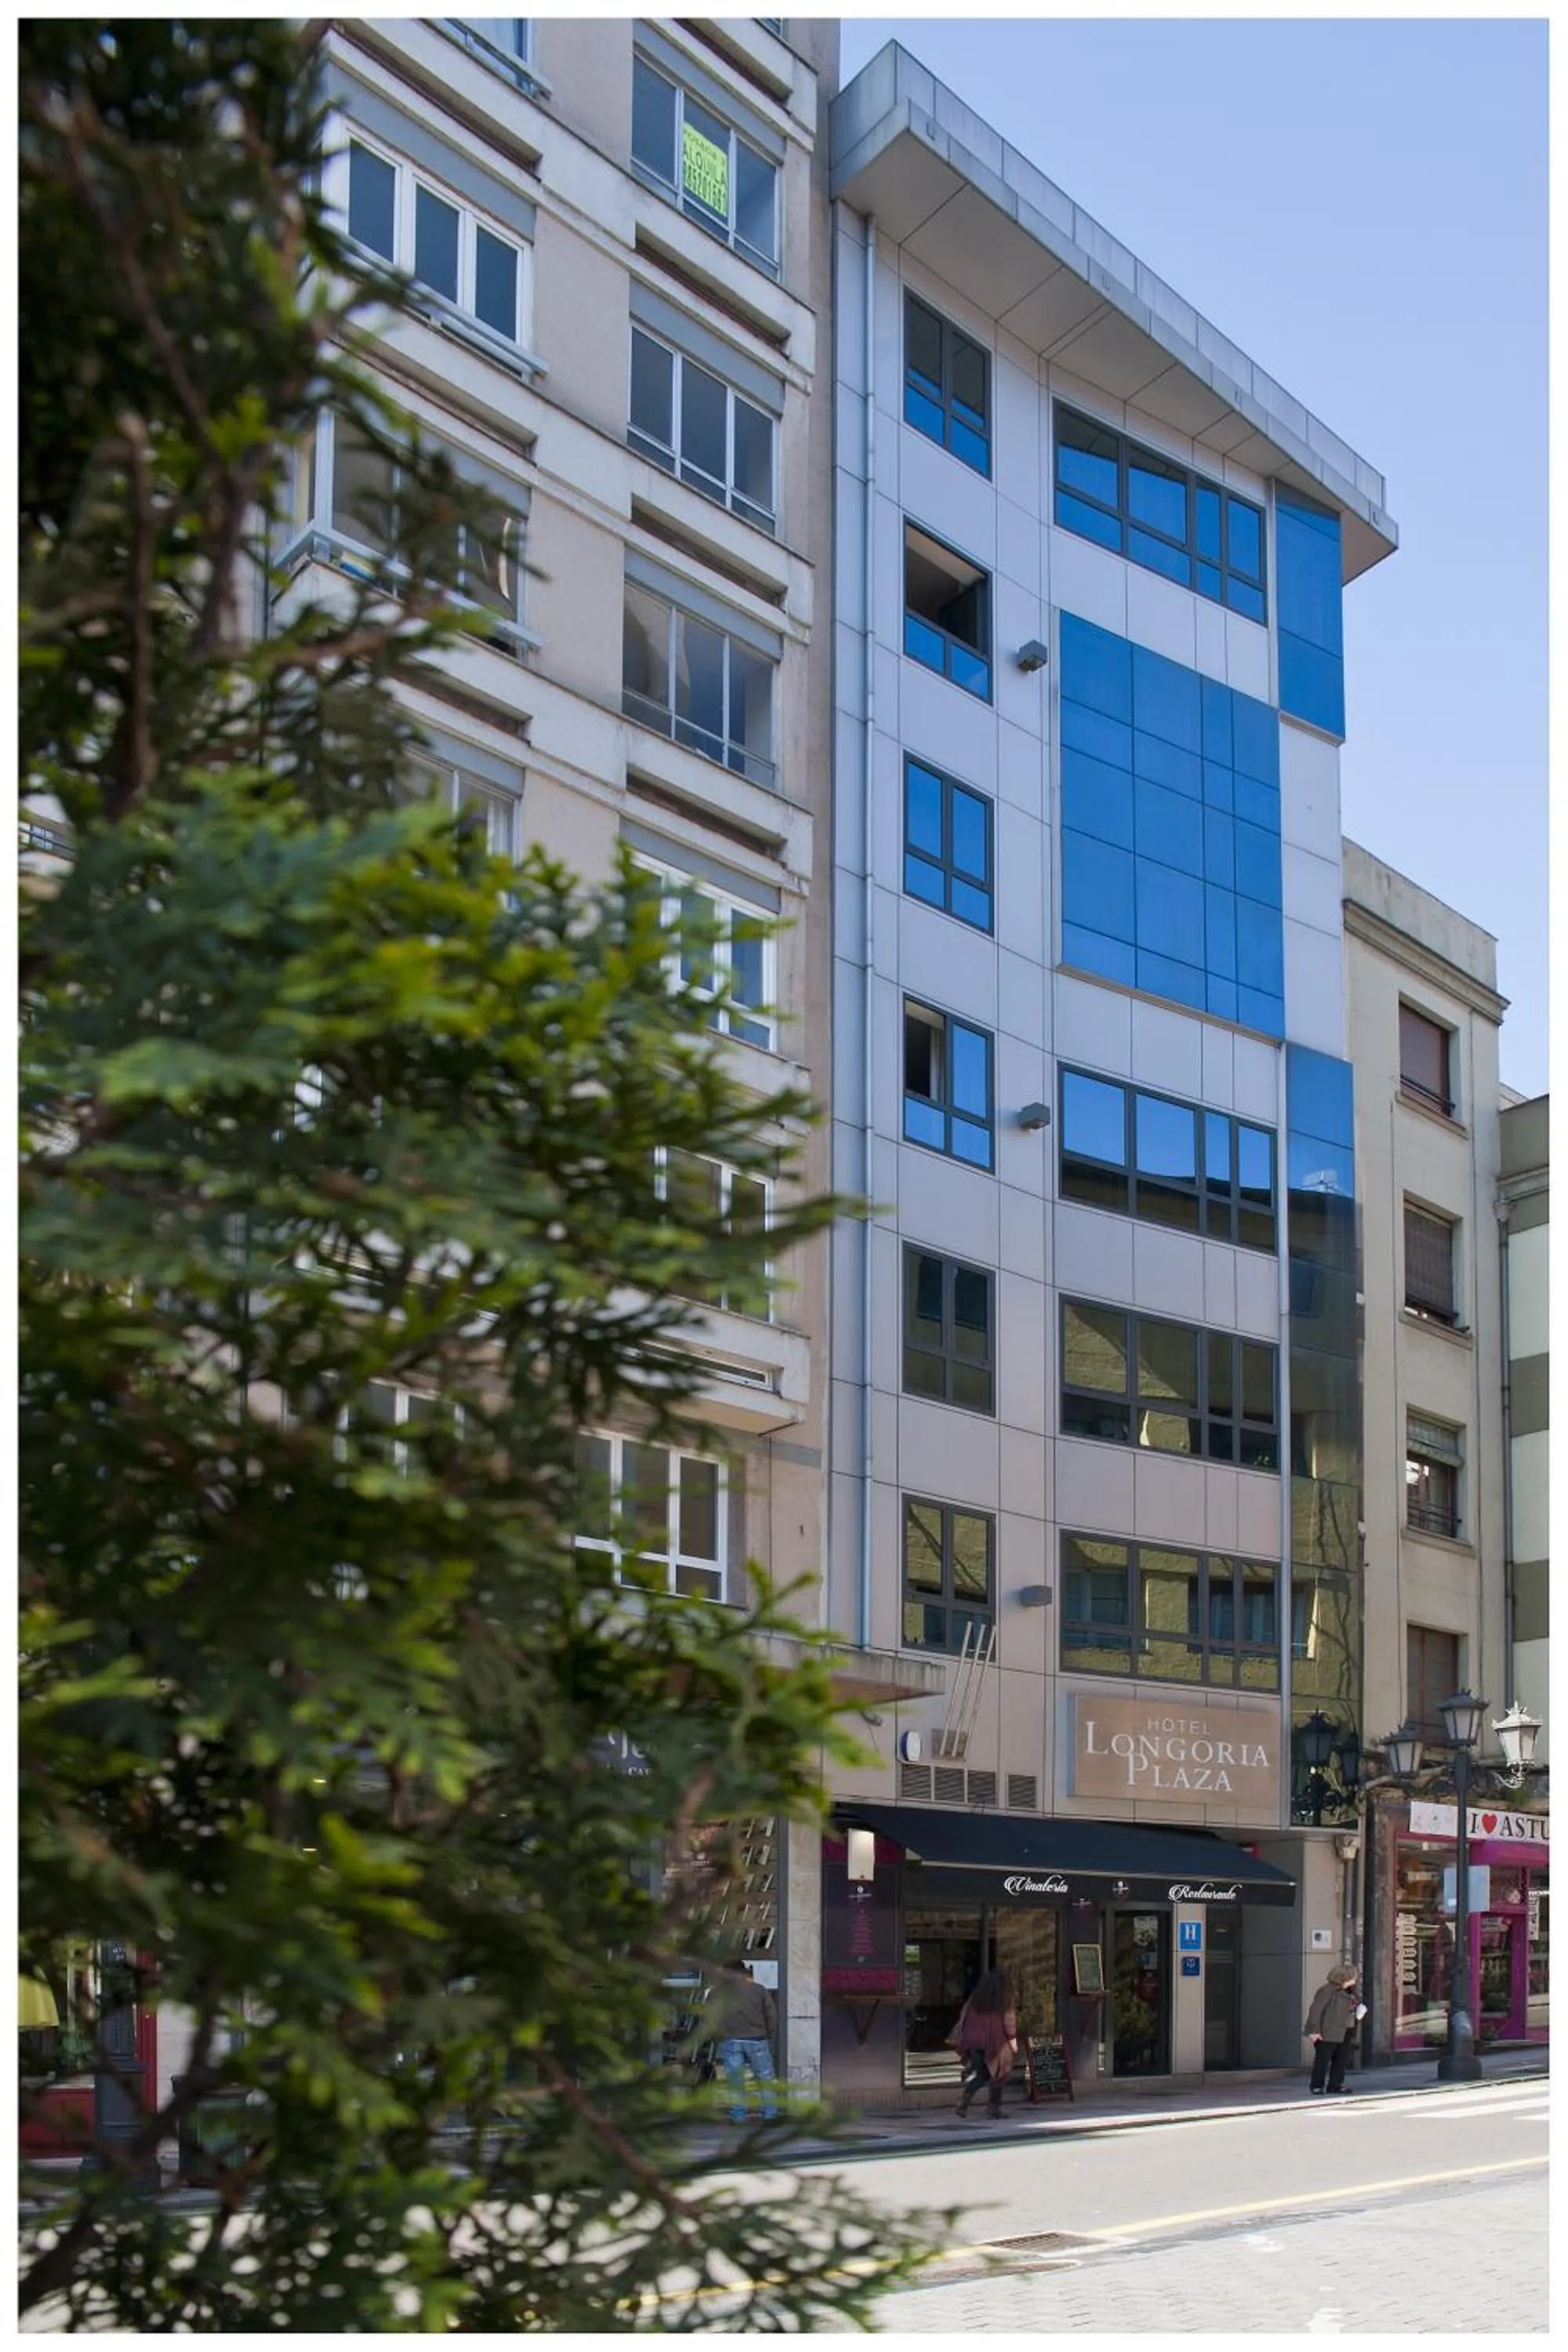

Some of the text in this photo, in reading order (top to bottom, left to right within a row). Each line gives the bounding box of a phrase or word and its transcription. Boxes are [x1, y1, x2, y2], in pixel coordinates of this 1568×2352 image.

[1148, 1718, 1211, 1735] HOTEL
[1086, 1721, 1269, 1767] LONGORIA
[1127, 1752, 1233, 1791] PLAZA
[1470, 1813, 1549, 1840] I ASTU
[1168, 1882, 1243, 1903] Restaurante
[1185, 1925, 1196, 1940] H
